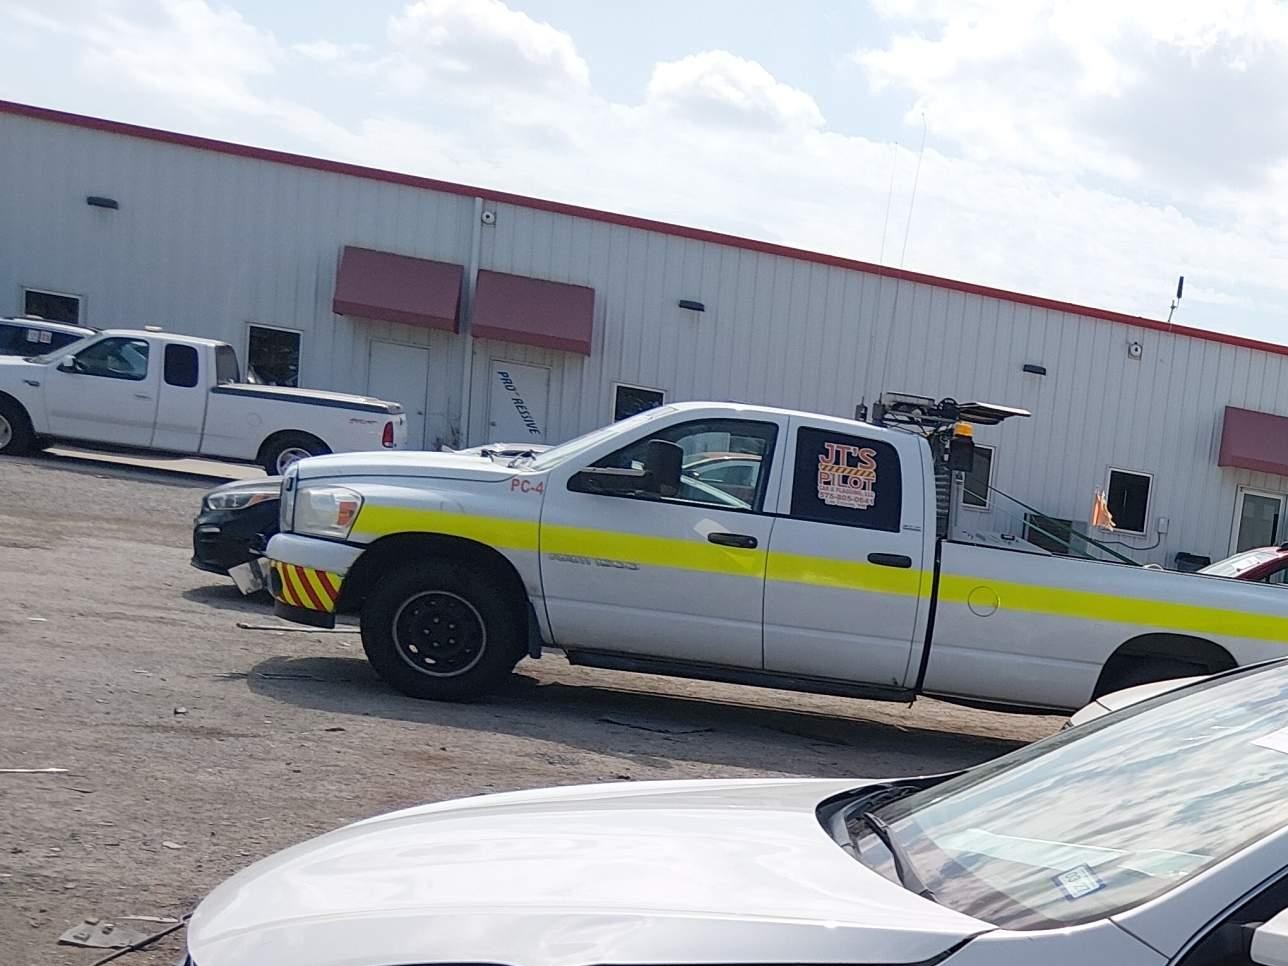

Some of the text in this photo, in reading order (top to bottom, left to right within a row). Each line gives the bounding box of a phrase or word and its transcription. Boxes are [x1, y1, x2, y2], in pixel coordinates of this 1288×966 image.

[497, 370, 541, 435] PRORESSIVE
[819, 442, 878, 470] JT'S
[510, 478, 545, 495] PC-4
[819, 471, 875, 491] PILOT
